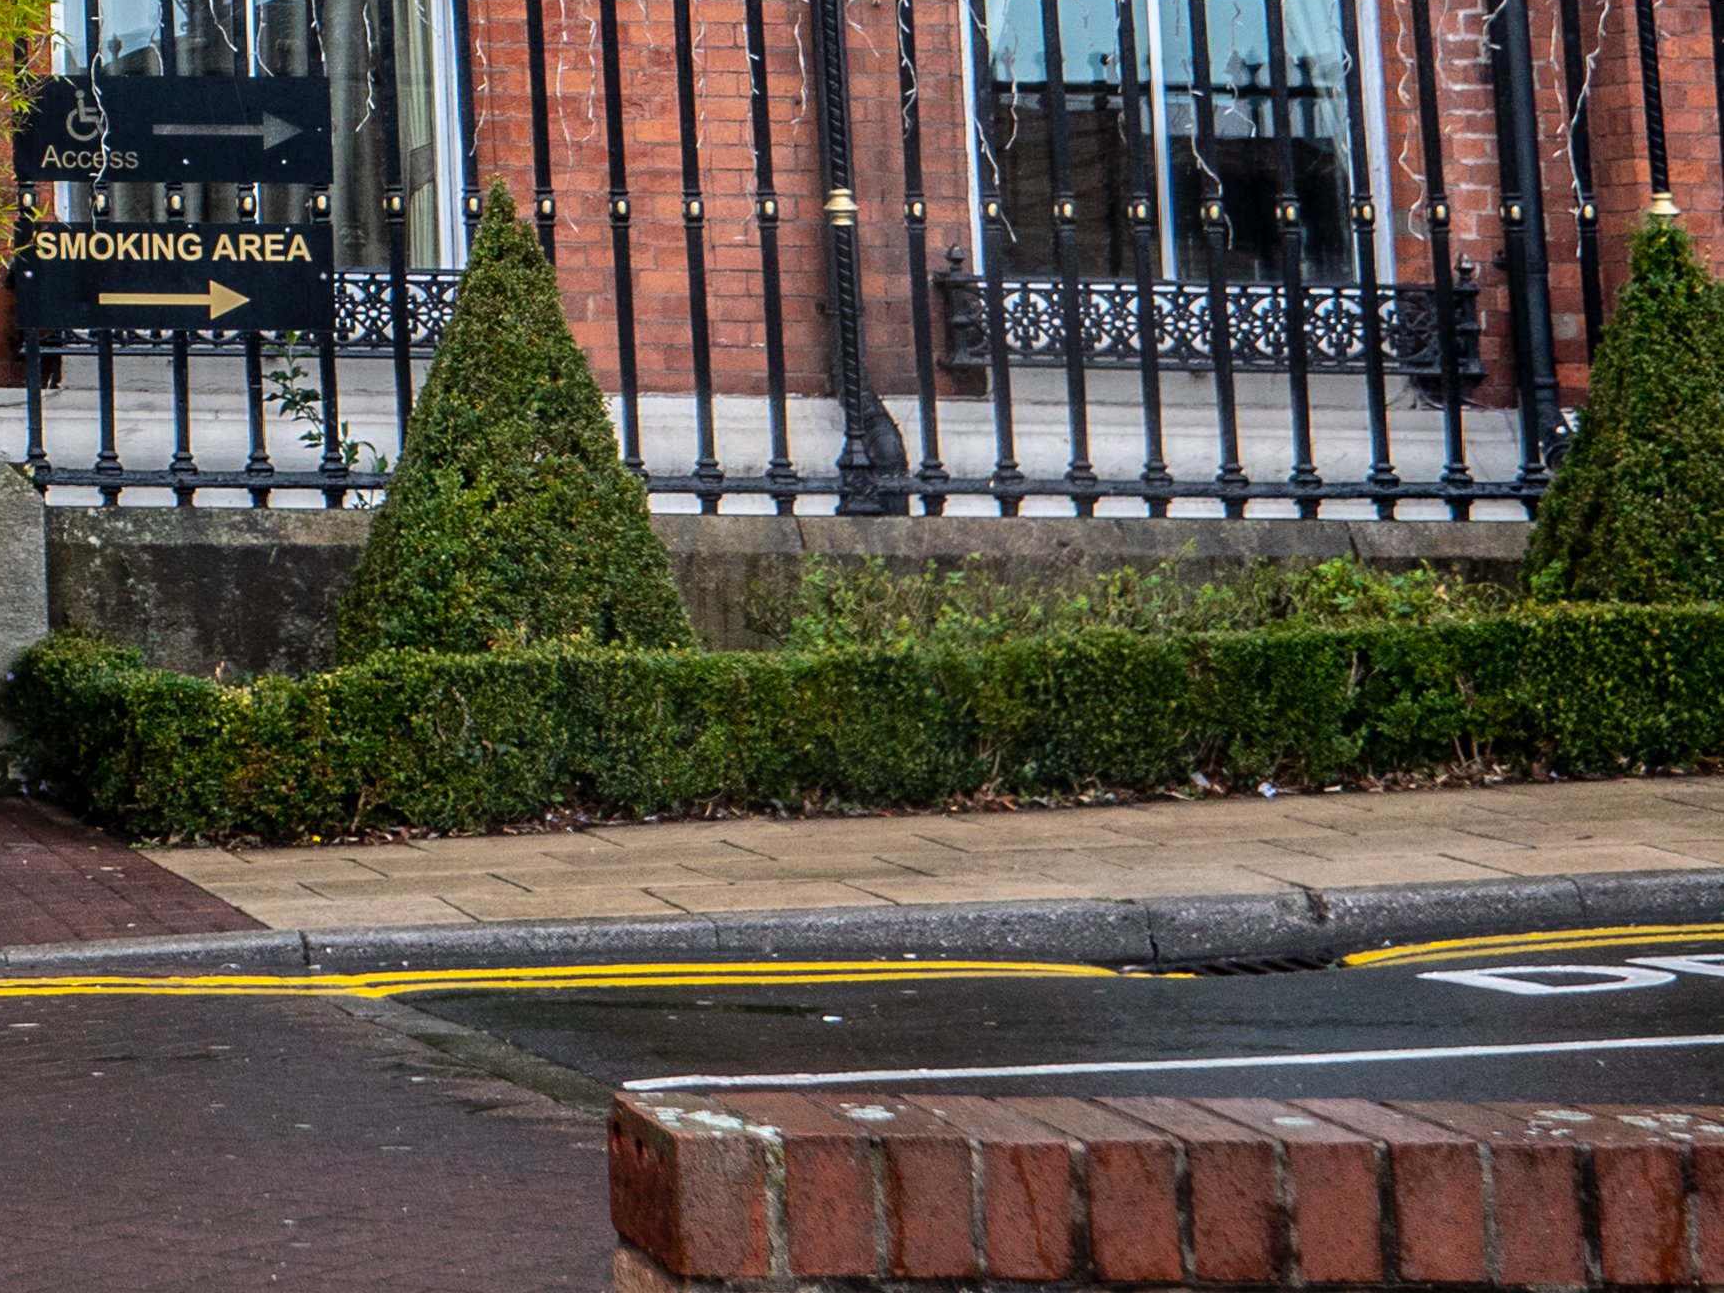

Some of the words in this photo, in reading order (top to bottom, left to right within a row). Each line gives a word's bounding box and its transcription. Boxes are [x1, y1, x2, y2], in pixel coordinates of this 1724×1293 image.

[41, 145, 138, 168] Access
[36, 232, 202, 261] SMOKING
[212, 233, 312, 262] AREA
